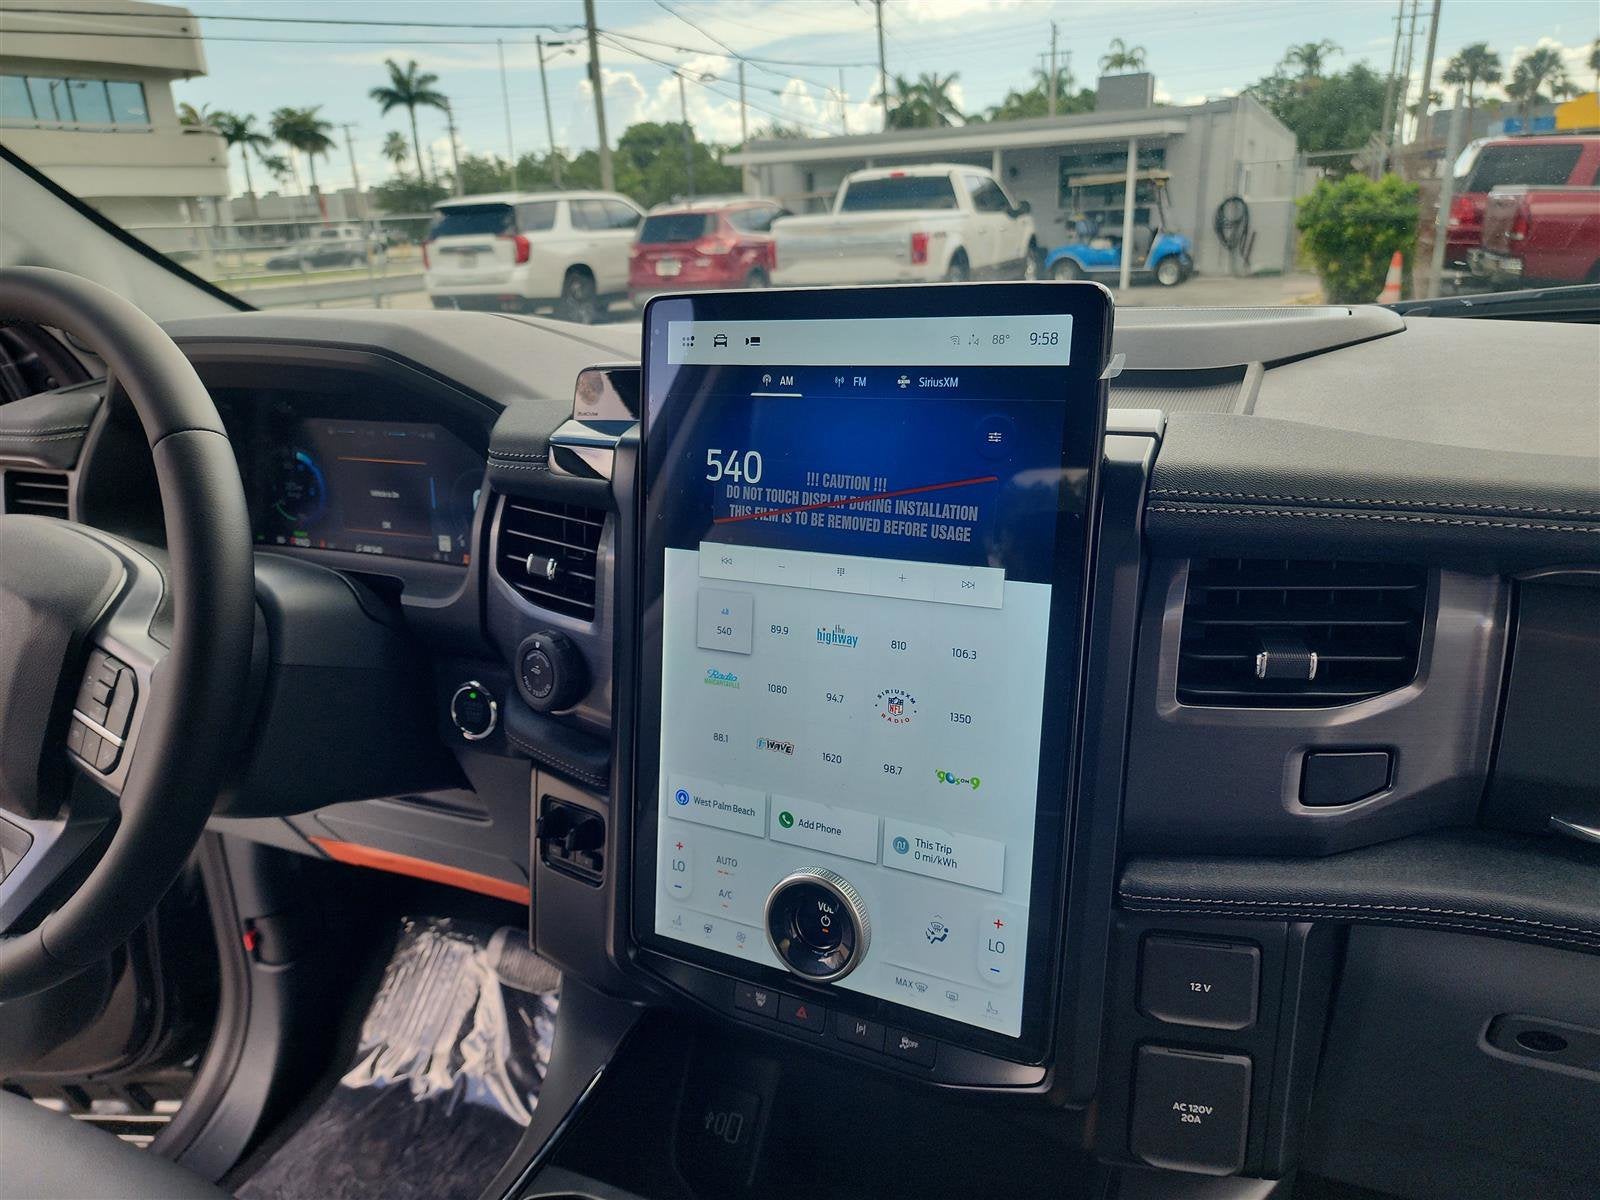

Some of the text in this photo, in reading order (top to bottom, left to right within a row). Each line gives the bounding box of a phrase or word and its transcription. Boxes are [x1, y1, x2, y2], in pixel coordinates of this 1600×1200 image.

[992, 334, 1011, 345] 88°
[1029, 332, 1059, 346] 9:58
[779, 375, 794, 386] AM
[853, 376, 867, 387] FM
[918, 376, 959, 388] SiriusXM
[705, 448, 763, 484] 540
[806, 471, 888, 492] !!! CAUTION !!!
[726, 484, 979, 522] DO NOT TOUCH DISPLAY DURING INSTALLATION
[729, 504, 972, 543] THIS FILM IS TO BE REMOVED BEFORE USAGE
[716, 625, 732, 636] 540
[770, 624, 789, 635] 89.9
[834, 624, 846, 634] the
[816, 628, 859, 648] highway
[890, 640, 907, 651] 810
[952, 647, 977, 660] 106.3
[707, 668, 738, 682] Radio
[767, 683, 788, 695] 1080
[826, 692, 844, 704] 94.7
[877, 689, 916, 704] SIRIUSXM
[889, 704, 903, 714] NFL
[880, 713, 910, 724] RADIO
[950, 712, 972, 724] 1350
[713, 732, 729, 743] 88.1
[822, 752, 842, 764] 1620
[883, 763, 903, 775] 98.7
[693, 795, 756, 817] West Palm Beach
[798, 818, 842, 836] Add Phone
[914, 837, 953, 855] This Trip
[672, 859, 686, 872] LO
[716, 855, 738, 868] AUTO
[914, 850, 958, 869] 0 mi/kWh
[718, 889, 733, 899] A/C
[817, 901, 835, 914] VOL
[988, 938, 1006, 954] LO
[895, 976, 914, 989] MAX
[1190, 982, 1212, 993] 12 V
[1172, 1101, 1213, 1116] AC 120V
[1180, 1113, 1202, 1124] 20A
